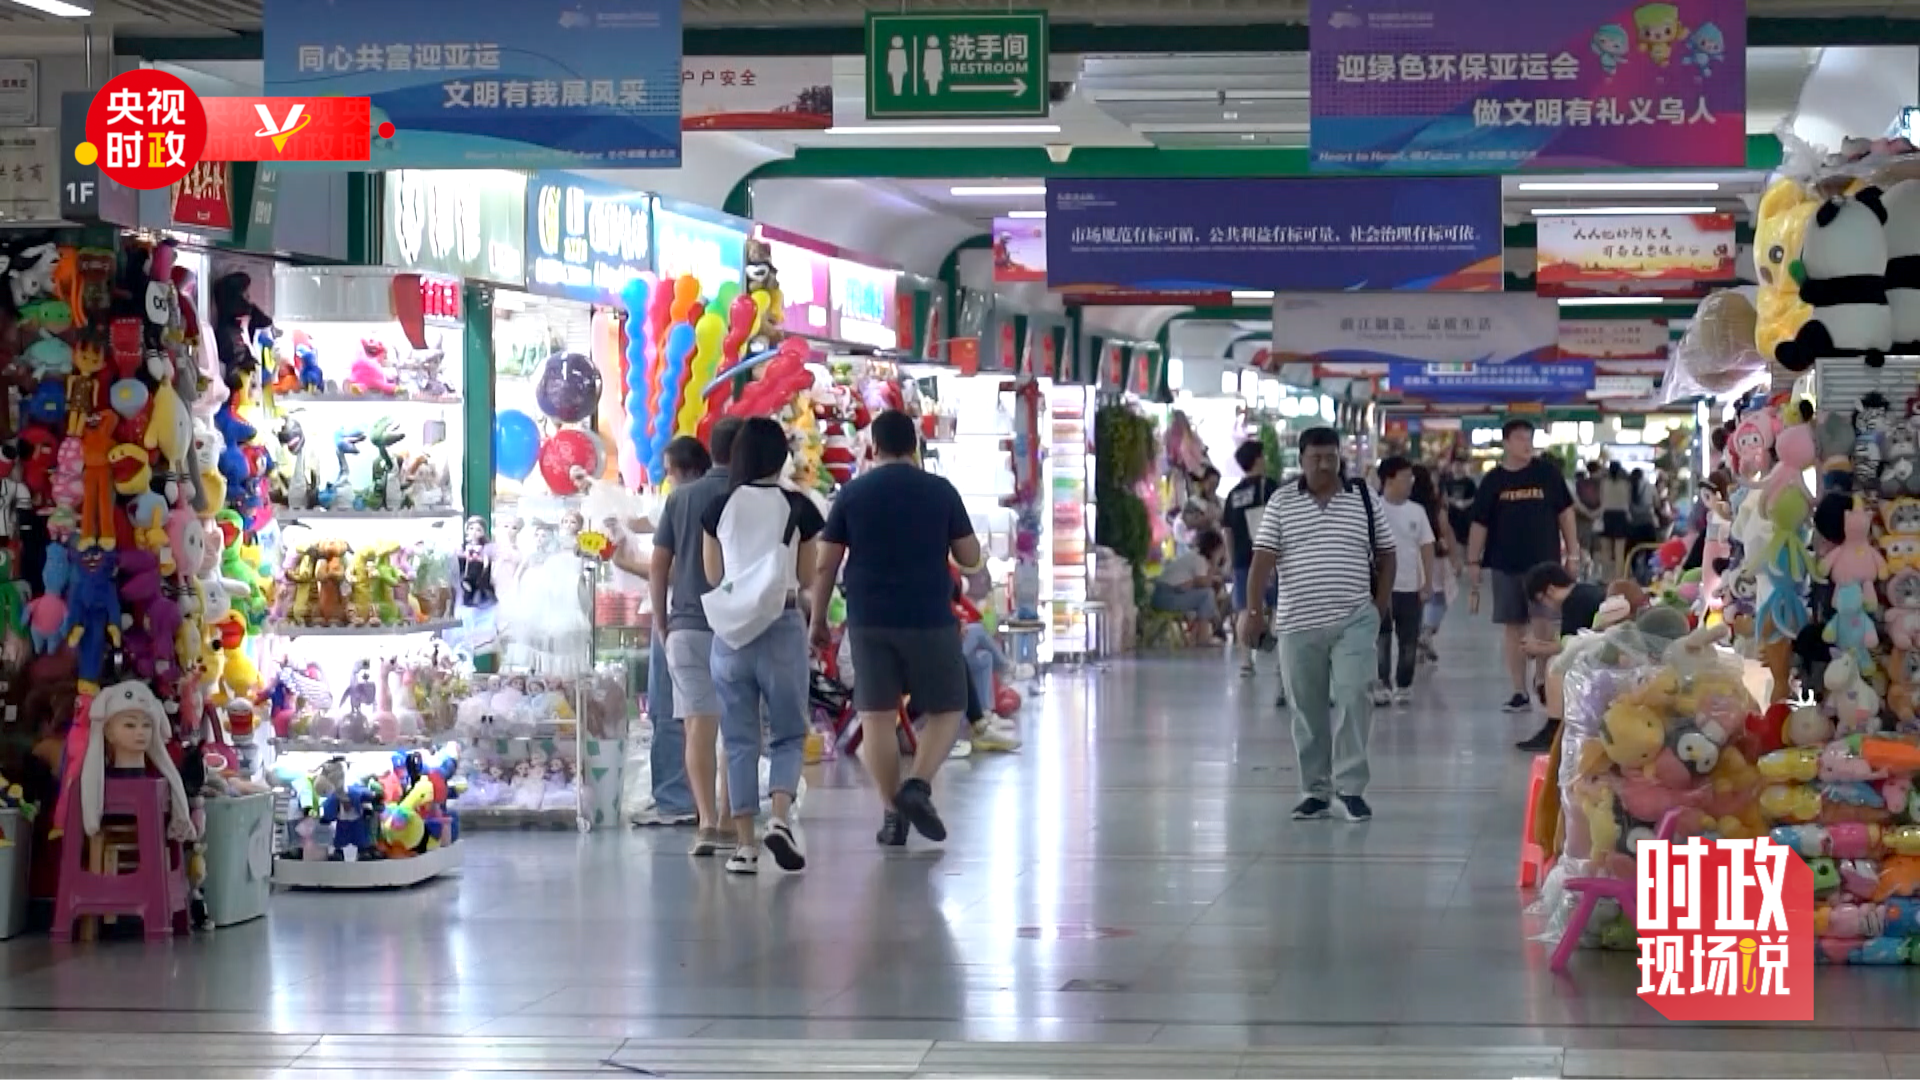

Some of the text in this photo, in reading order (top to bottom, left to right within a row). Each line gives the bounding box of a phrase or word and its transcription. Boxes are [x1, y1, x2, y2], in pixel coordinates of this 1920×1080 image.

[299, 43, 500, 72] 同心共富迎亚运
[950, 35, 1029, 60] 洗手间
[950, 63, 1029, 74] RESTROOM
[1336, 53, 1580, 82] 迎绿色环保亚运会
[443, 79, 649, 108] 文明有我展风采
[1472, 98, 1717, 127] 做文明有礼义乌人
[66, 182, 95, 205] 1F
